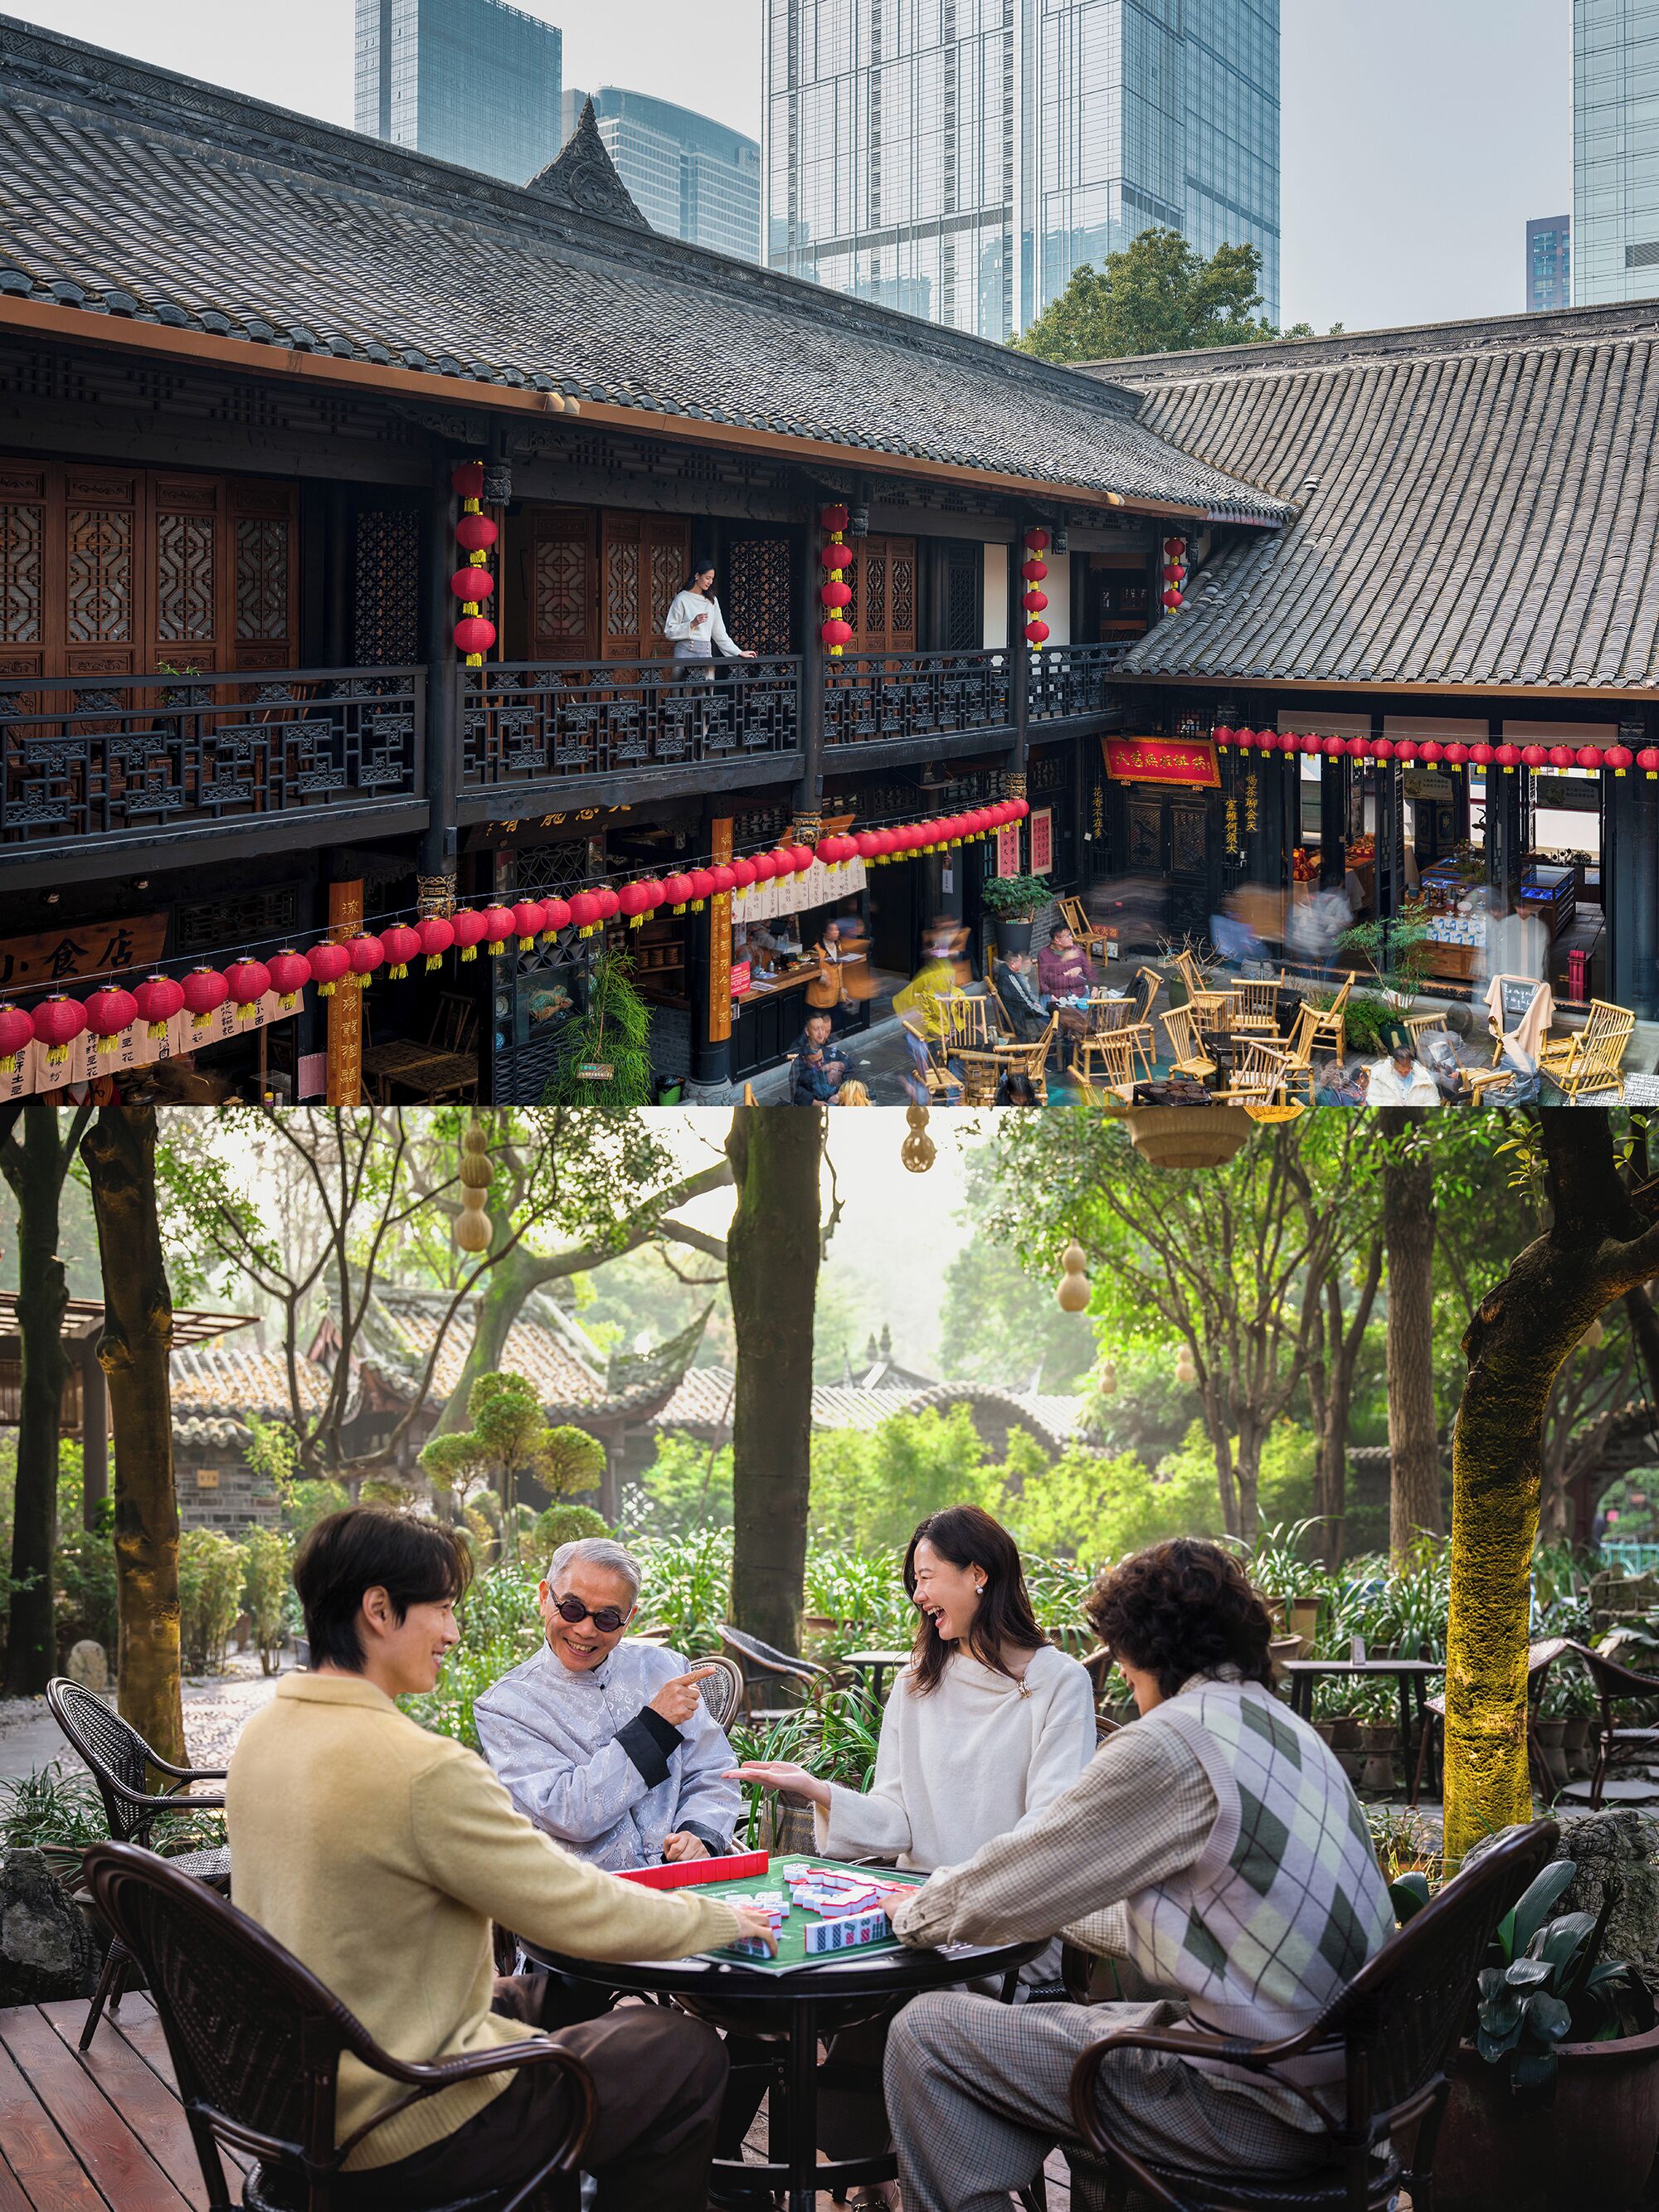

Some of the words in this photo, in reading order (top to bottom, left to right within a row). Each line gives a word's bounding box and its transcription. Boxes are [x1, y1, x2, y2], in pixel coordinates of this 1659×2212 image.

[1092, 786, 1103, 839] 花香不在多
[1226, 800, 1238, 854] 室雅何须大
[1245, 775, 1258, 832] 喝茶聊会天
[0, 928, 134, 983] 小食店
[1092, 926, 1117, 937] 灭火器
